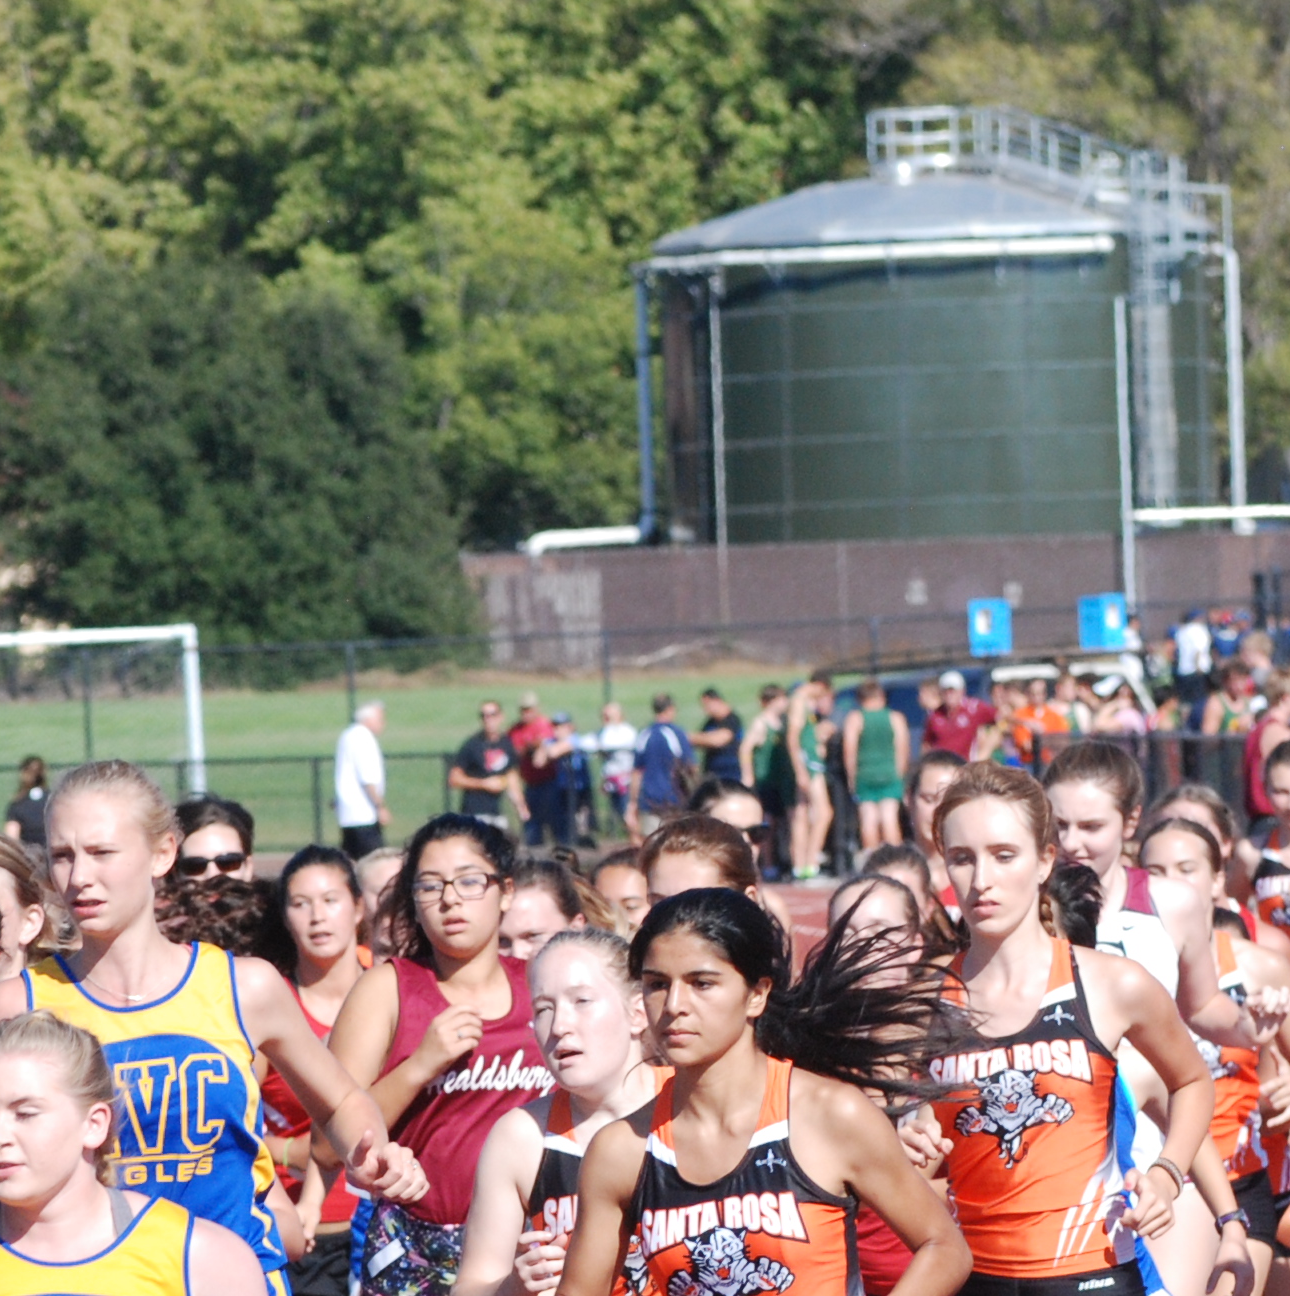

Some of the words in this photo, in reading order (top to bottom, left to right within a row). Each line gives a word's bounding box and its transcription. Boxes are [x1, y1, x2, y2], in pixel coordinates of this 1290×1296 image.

[929, 1047, 1009, 1085] SANTA
[1012, 1038, 1093, 1082] ROSA
[103, 1053, 229, 1160] VC
[642, 1199, 720, 1256] SANTA
[723, 1191, 810, 1243] ROSA
